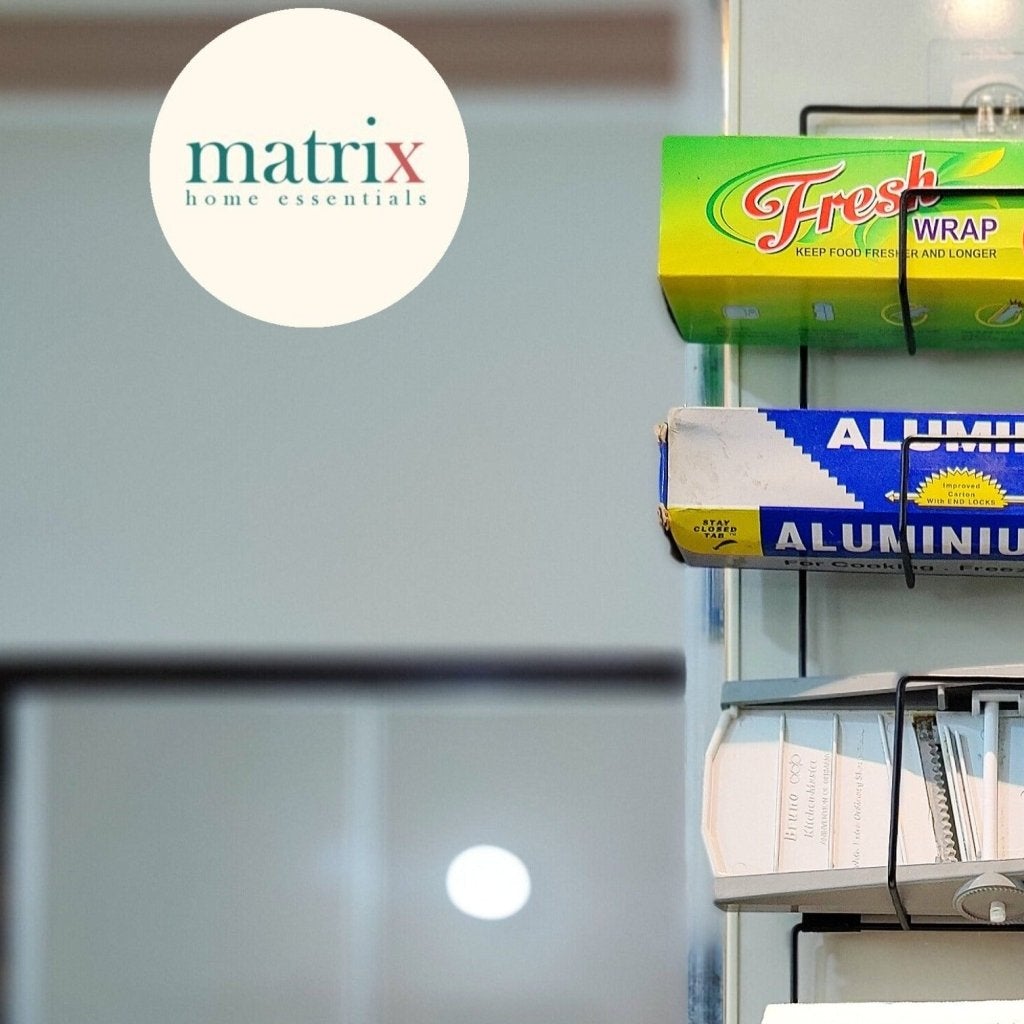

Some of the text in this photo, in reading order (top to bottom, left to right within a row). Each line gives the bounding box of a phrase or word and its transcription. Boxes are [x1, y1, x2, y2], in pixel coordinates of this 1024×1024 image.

[742, 150, 939, 254] Fresh
[913, 217, 998, 242] WRAP
[796, 247, 826, 257] KEEP
[829, 247, 862, 258] FOOD
[921, 248, 946, 259] AND
[949, 248, 997, 259] LONGER
[942, 482, 981, 490] Improved
[784, 559, 825, 568] For
